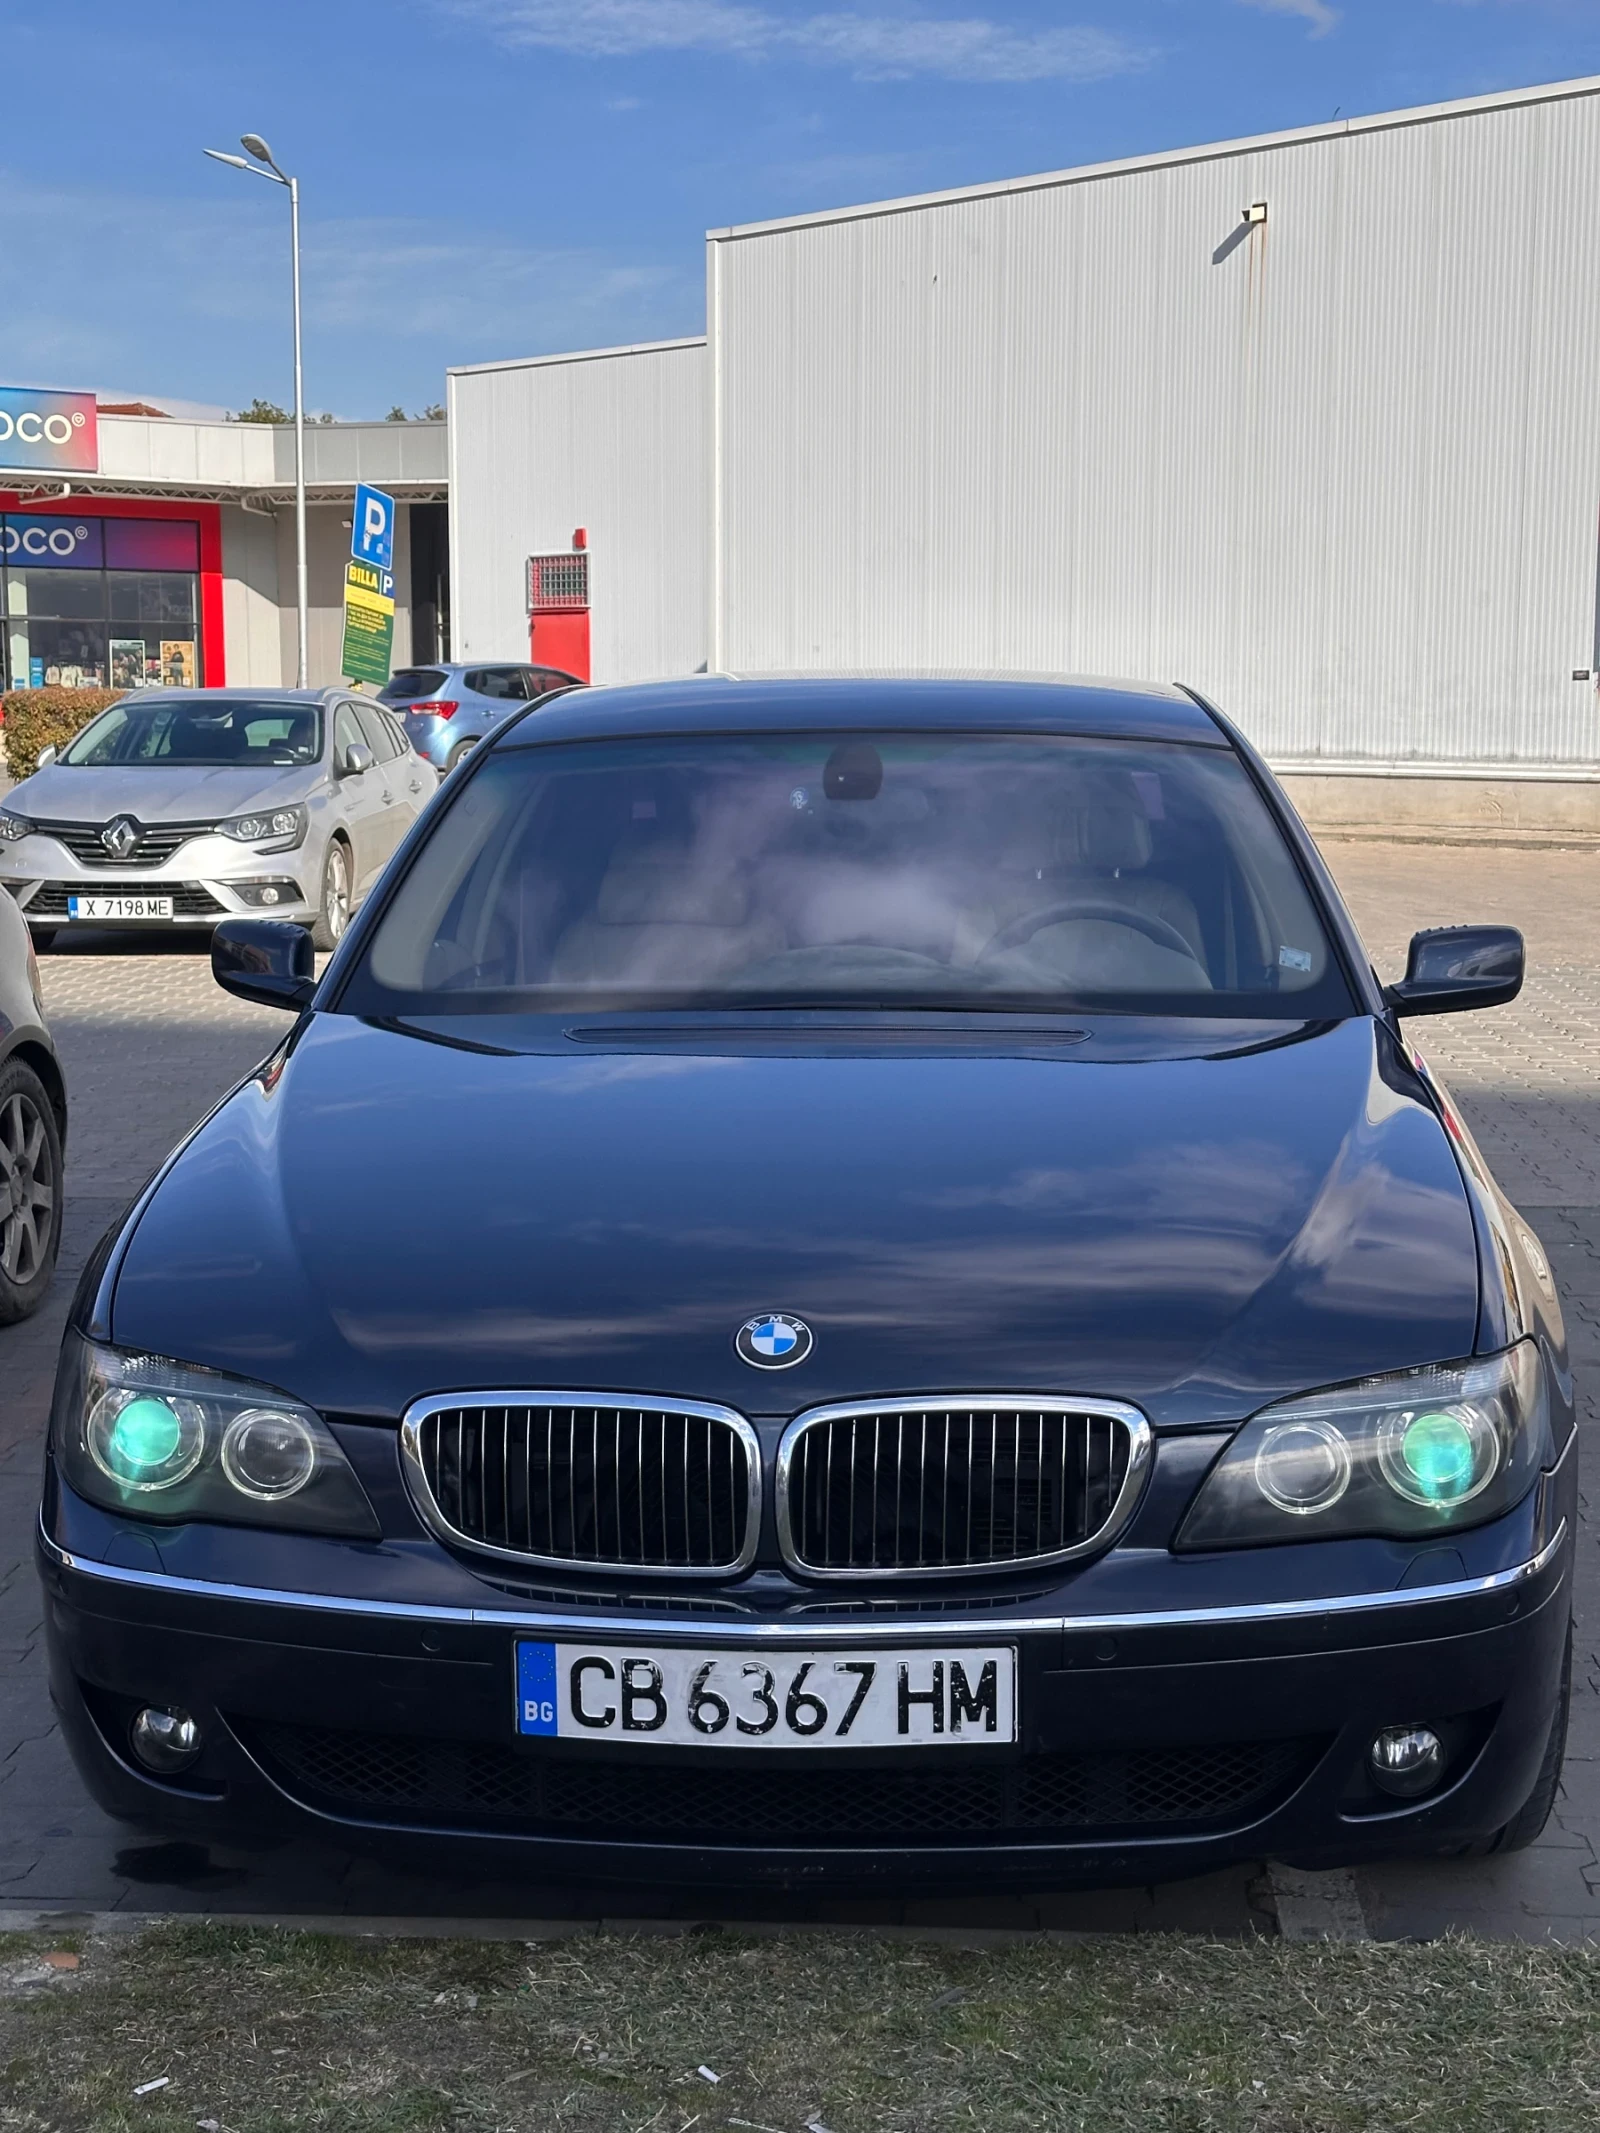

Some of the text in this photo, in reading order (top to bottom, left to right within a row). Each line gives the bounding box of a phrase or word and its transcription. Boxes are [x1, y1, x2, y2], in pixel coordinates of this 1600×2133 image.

[363, 496, 386, 551] P
[349, 564, 393, 594] BILLA P
[86, 900, 169, 916] X 7198 ME
[745, 1315, 806, 1332] BMW
[569, 1655, 998, 1736] CB 6367 HM
[524, 1699, 554, 1723] BG
